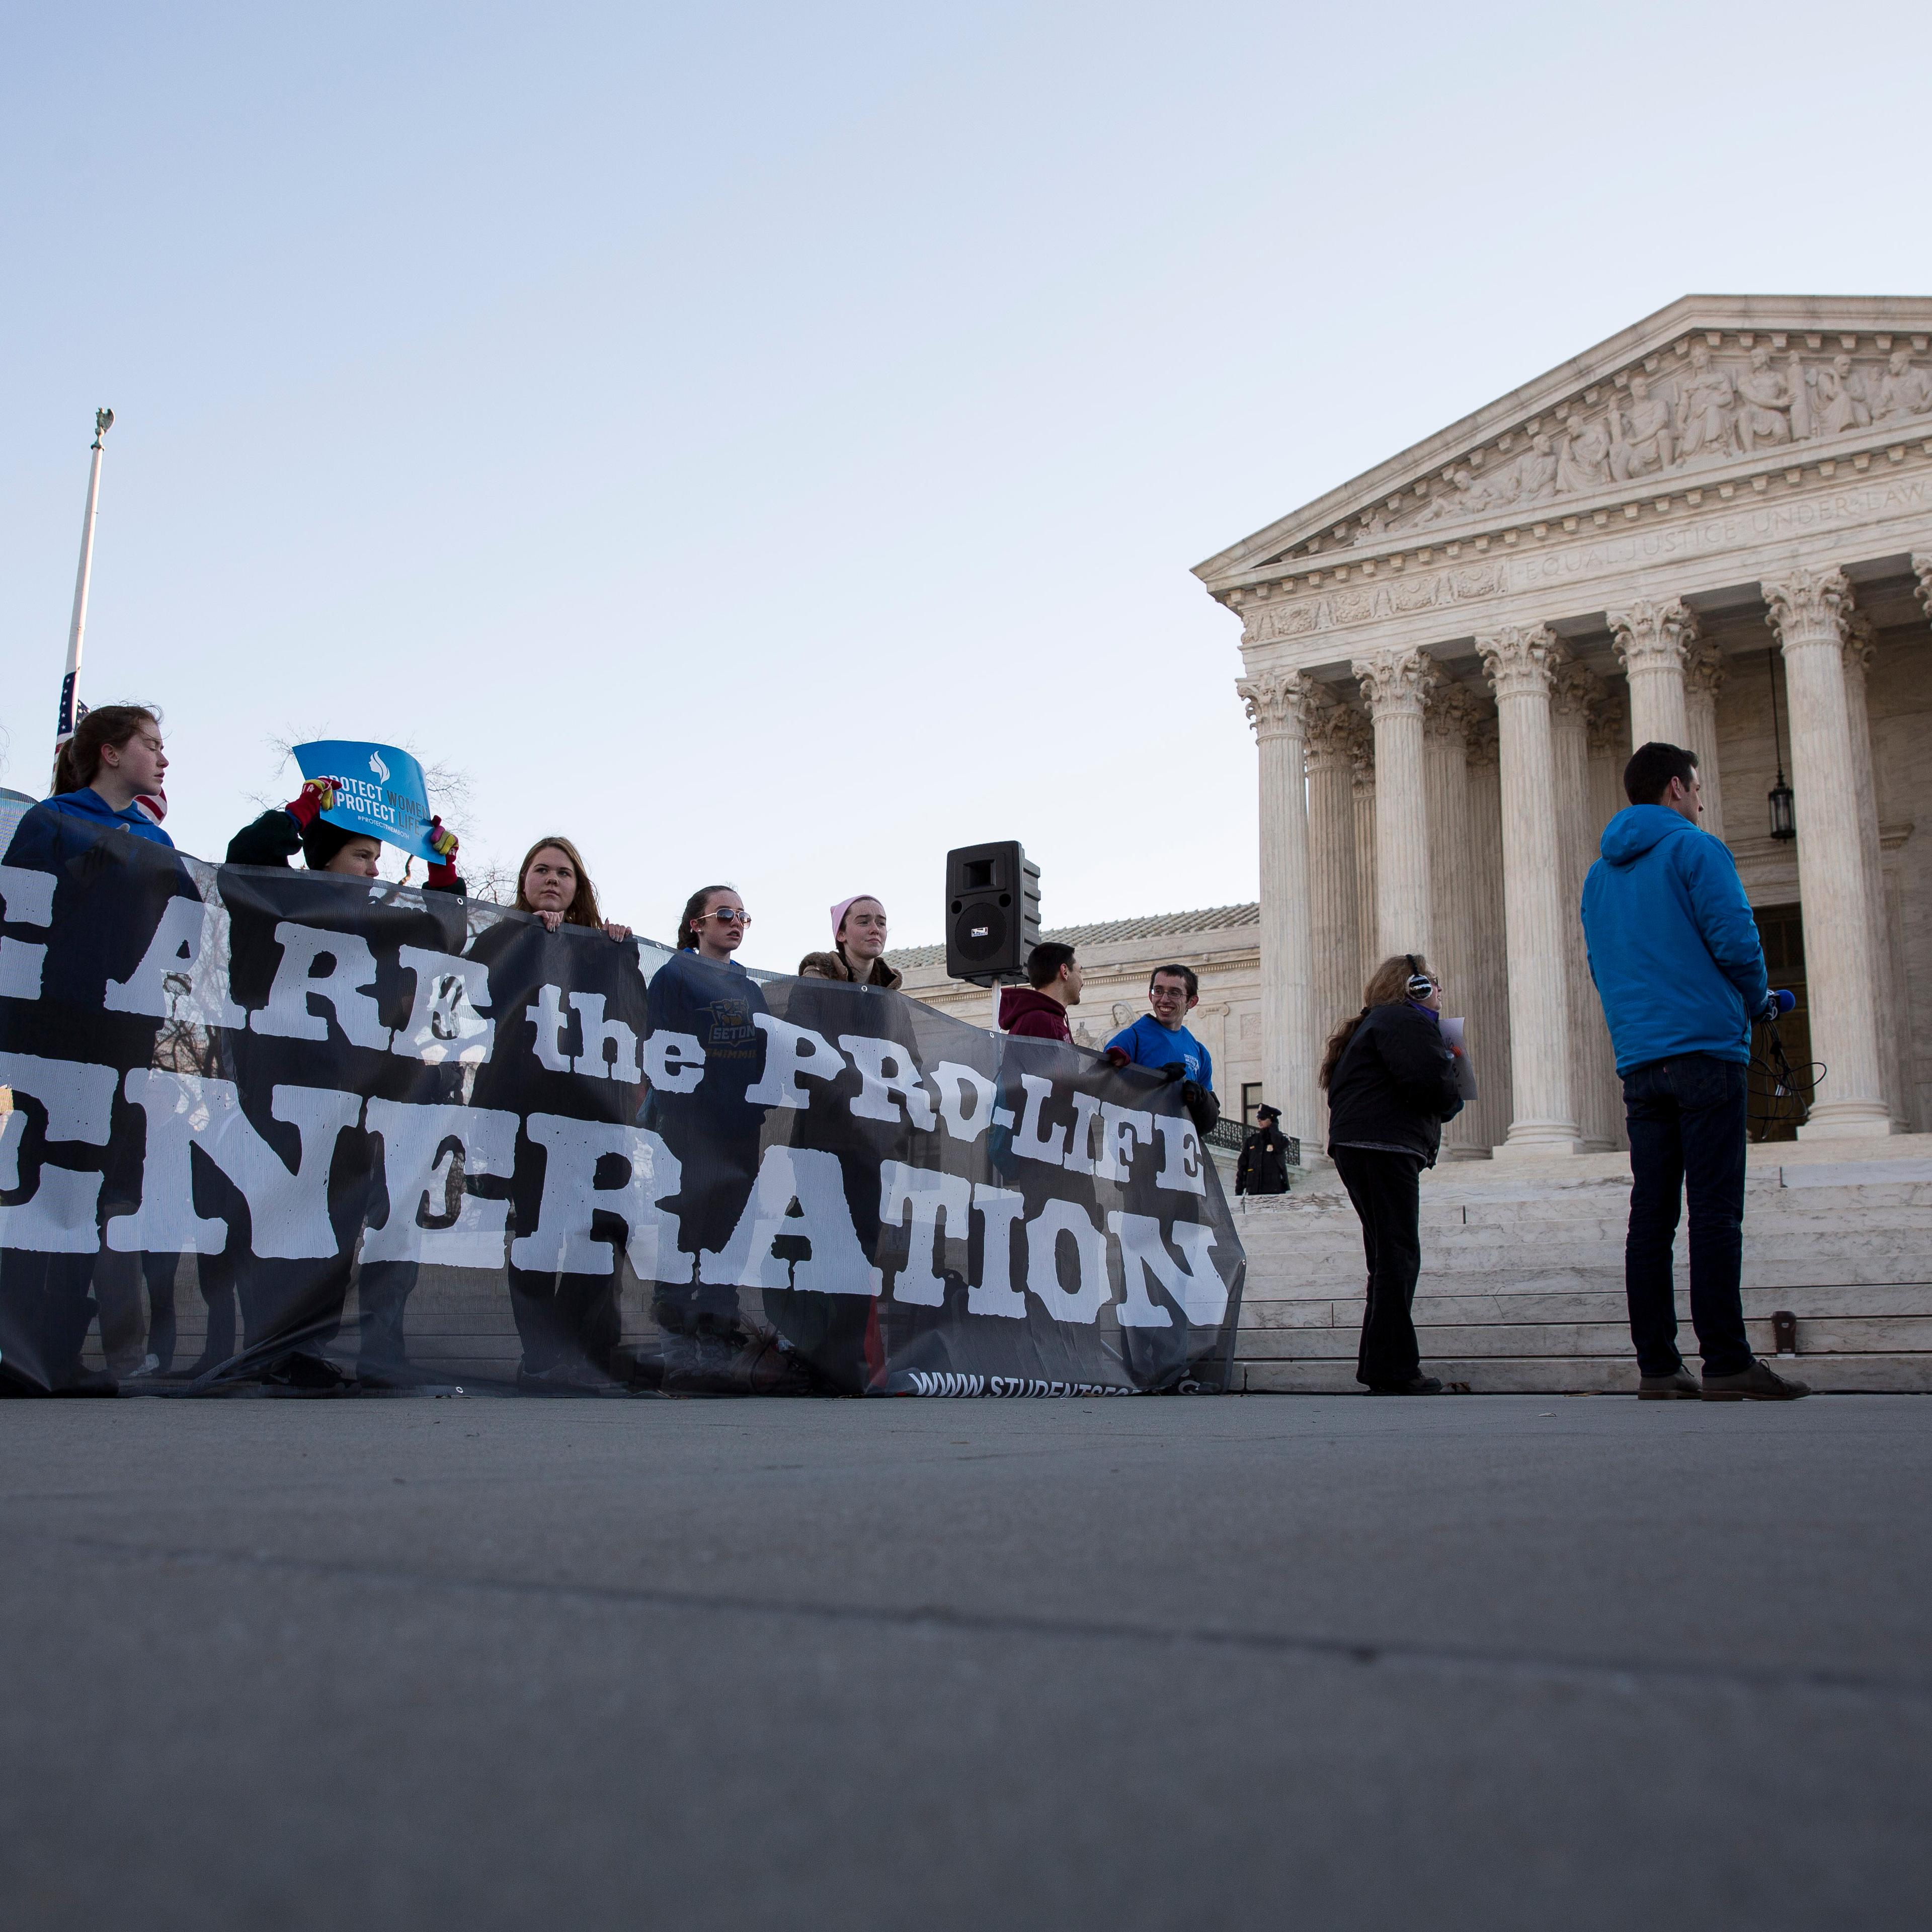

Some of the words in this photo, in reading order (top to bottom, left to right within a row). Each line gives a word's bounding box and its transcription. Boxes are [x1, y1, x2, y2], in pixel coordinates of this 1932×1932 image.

[1526, 545, 1618, 580] EQUAL
[1626, 520, 1737, 561] JUSTICE
[1752, 497, 1859, 533] UNDER
[1866, 480, 1926, 511] LAW
[318, 775, 382, 802] OTECT
[386, 789, 429, 820] WOMEN
[337, 791, 395, 824] PROTECT
[358, 815, 410, 840] #PROTECTTHEMBOTH
[104, 895, 496, 1065] ARE
[526, 983, 704, 1094] the
[746, 1013, 1206, 1196] PRO-LIFE
[713, 1025, 755, 1040] SETON
